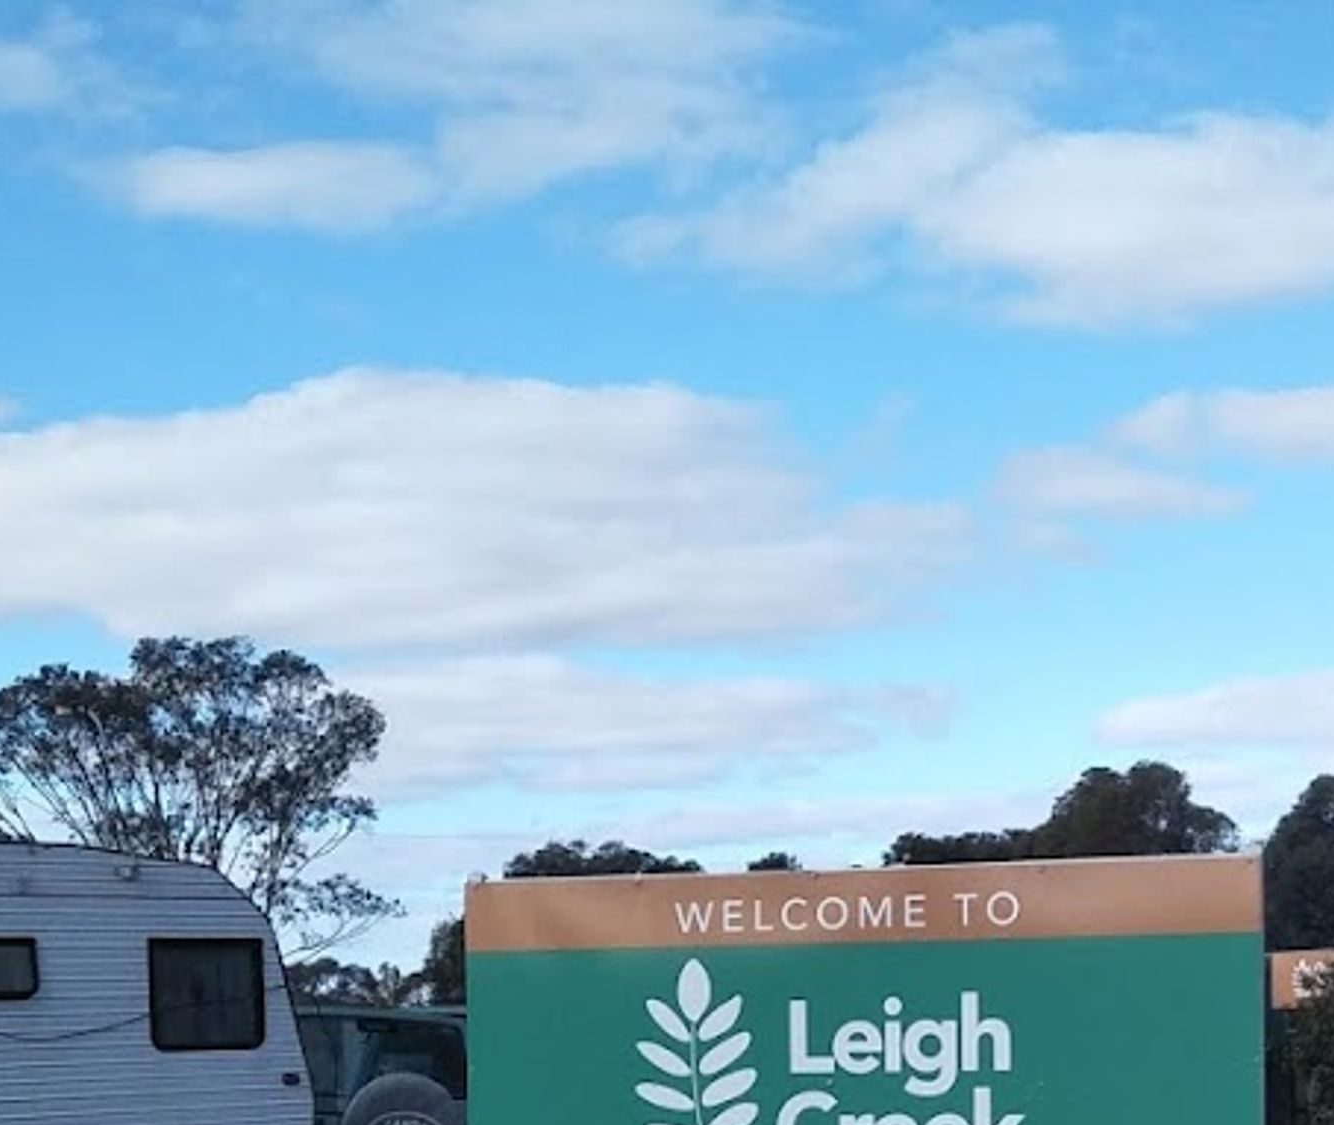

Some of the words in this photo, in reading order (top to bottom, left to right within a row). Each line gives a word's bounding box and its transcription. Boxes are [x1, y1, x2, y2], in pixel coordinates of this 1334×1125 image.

[674, 896, 927, 933] WELCOME
[954, 891, 1020, 926] TO
[788, 990, 1012, 1097] Leigh
